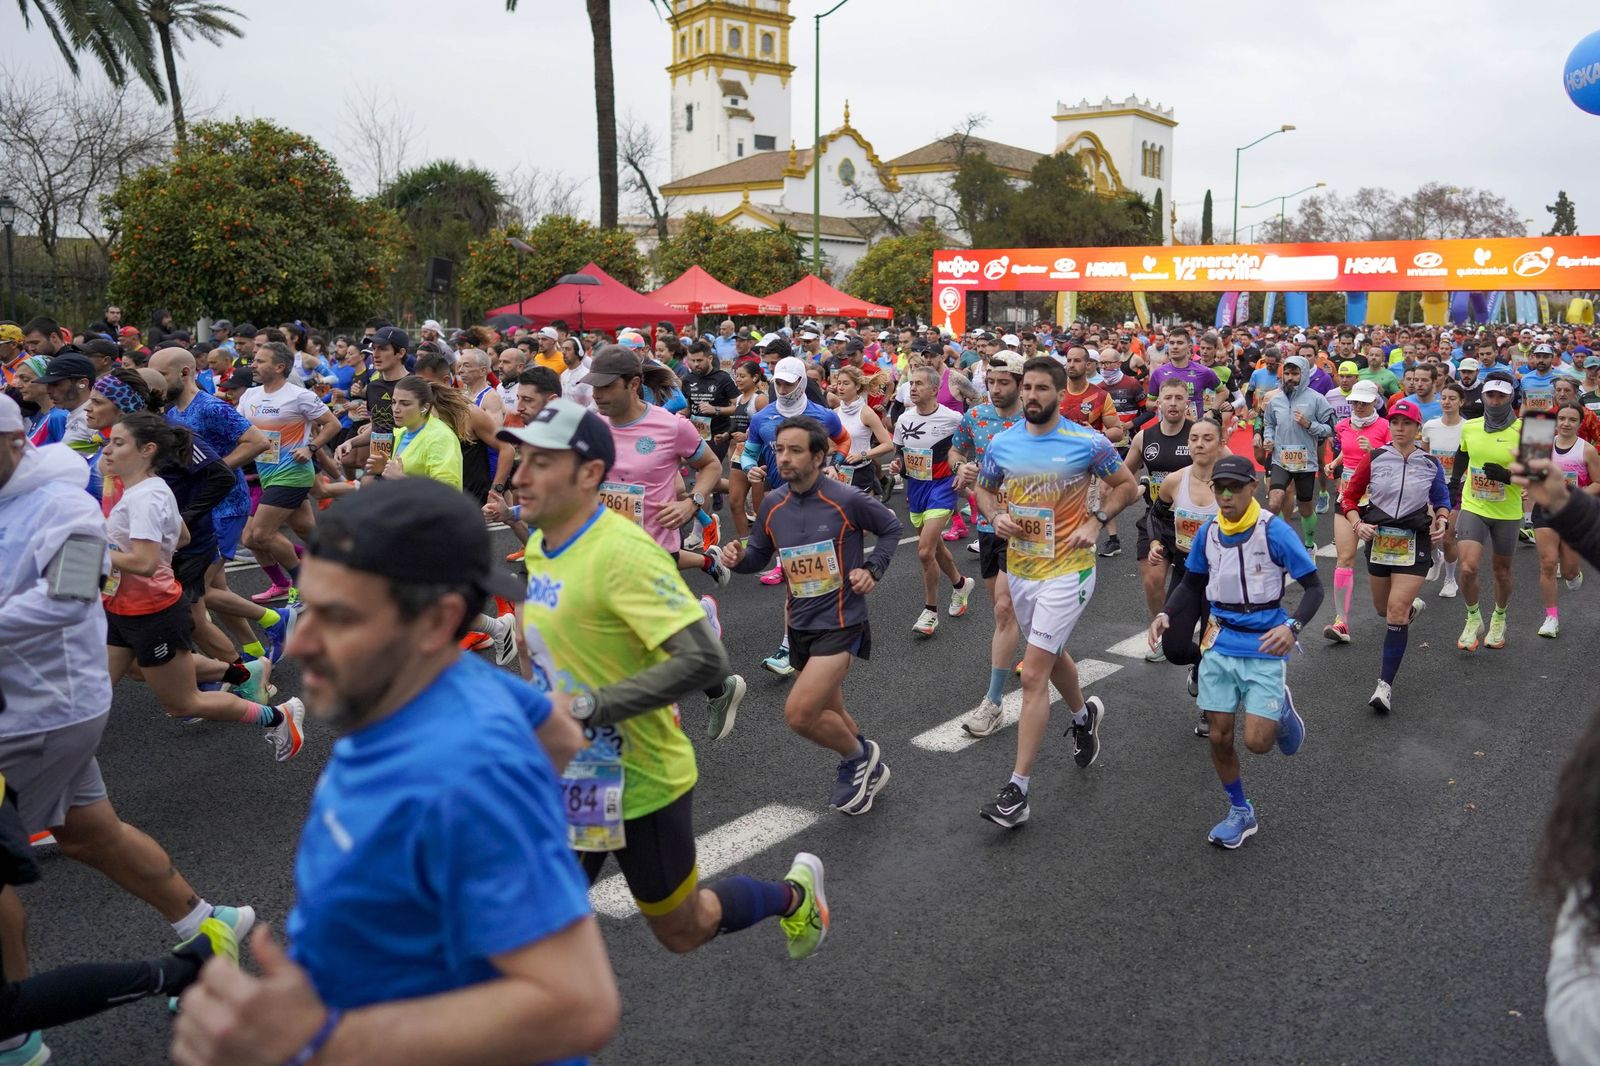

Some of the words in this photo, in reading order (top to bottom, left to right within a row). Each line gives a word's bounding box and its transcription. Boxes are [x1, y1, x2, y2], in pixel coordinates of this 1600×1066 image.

[1085, 261, 1128, 277] HOKA
[1344, 256, 1398, 275] HOKA
[1407, 268, 1448, 277] HYUNDAI
[907, 454, 924, 467] 6927
[1284, 451, 1303, 460] 8070
[1474, 475, 1496, 488] 5524
[599, 493, 629, 512] 7861
[791, 556, 824, 575] 4574
